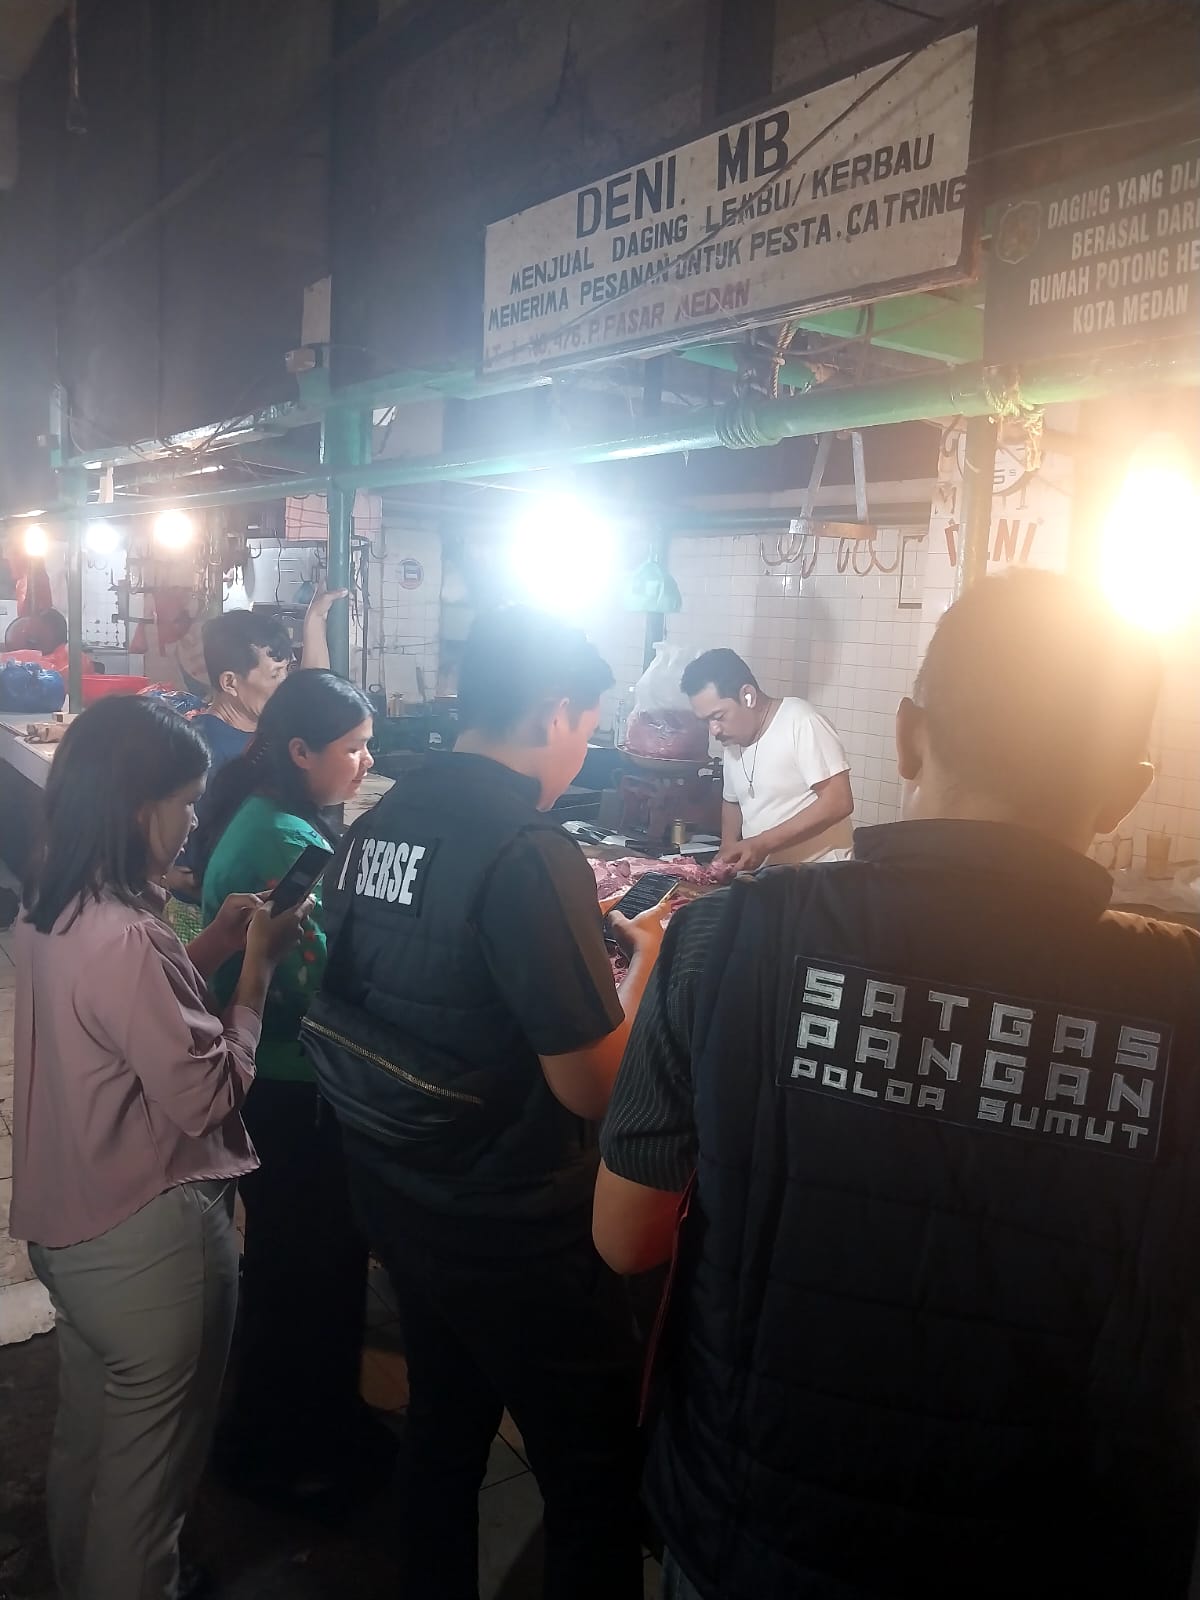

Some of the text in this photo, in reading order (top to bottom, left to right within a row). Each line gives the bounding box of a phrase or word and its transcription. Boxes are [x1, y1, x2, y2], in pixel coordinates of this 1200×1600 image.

[717, 110, 790, 192] MB
[510, 246, 595, 295] MENJUAL
[612, 214, 689, 262] DAGING
[812, 133, 935, 200] KERBAU
[1048, 185, 1110, 229] DAGING
[1117, 169, 1163, 209] YANG
[488, 287, 569, 331] MENERIMA
[580, 252, 670, 306] PESANAN
[675, 236, 743, 282] UNTUK
[846, 174, 967, 236] CATRING
[1072, 213, 1149, 260] BERASAL
[675, 279, 750, 322] MEDAN
[1029, 266, 1090, 306] RUMAH
[1095, 247, 1169, 290] POTONG
[1073, 284, 1188, 333] KOTA MEDAN
[338, 838, 426, 905] SERSE
[803, 966, 1161, 1071] SATGAS
[796, 1012, 1154, 1118] PANGAN
[791, 1056, 1149, 1150] POLDA SUMUT
